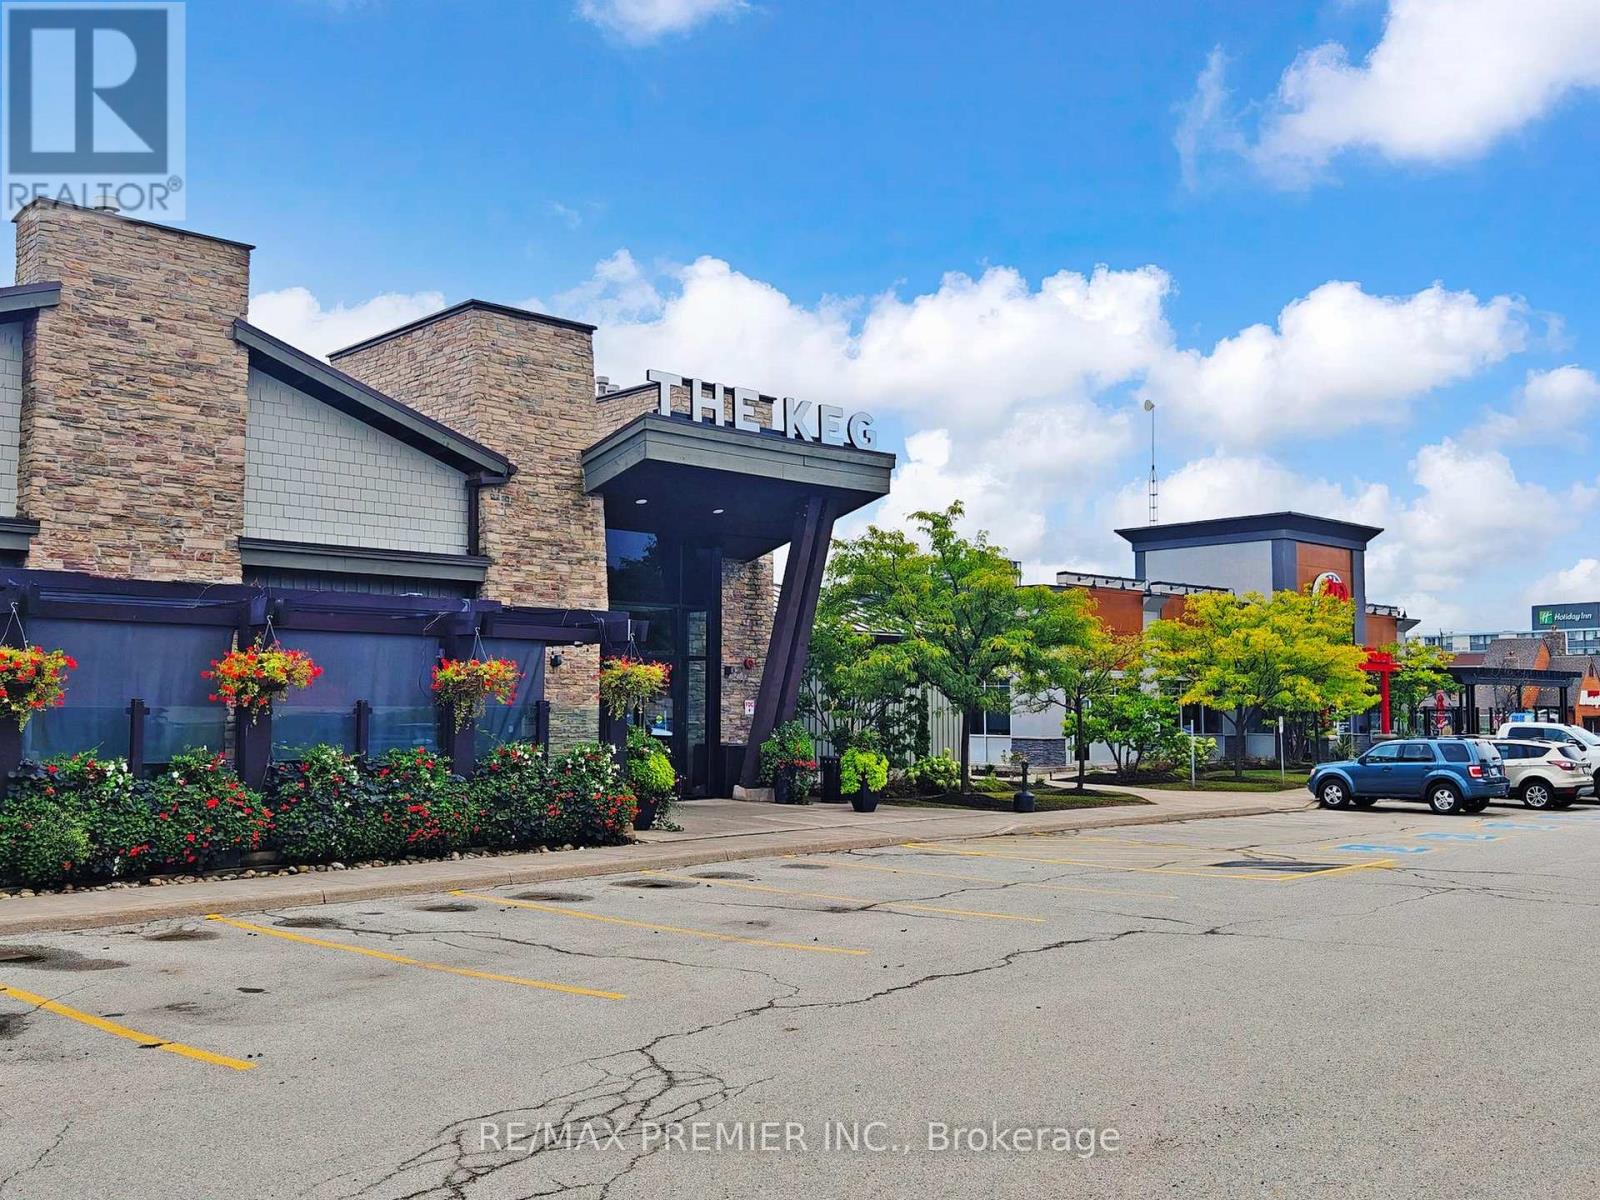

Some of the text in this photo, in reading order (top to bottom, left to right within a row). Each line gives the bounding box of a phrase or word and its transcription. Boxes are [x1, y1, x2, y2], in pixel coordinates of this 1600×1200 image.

[646, 369, 877, 450] THE KEG
[1554, 612, 1580, 622] Holiday
[1580, 612, 1592, 620] Inn
